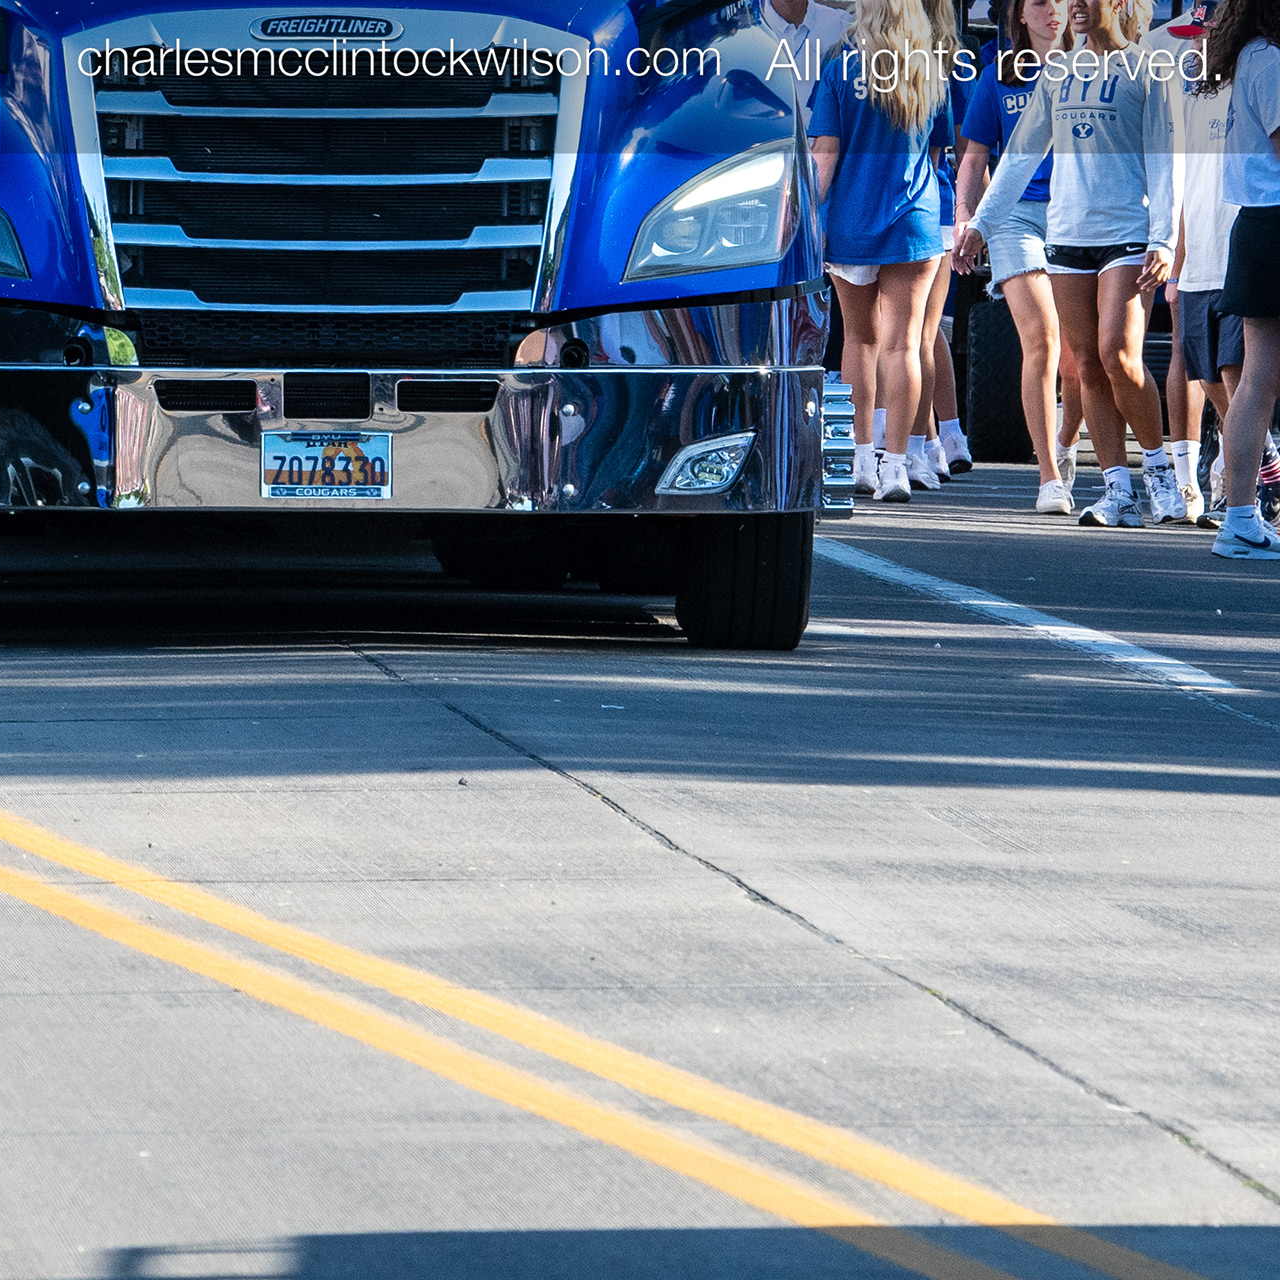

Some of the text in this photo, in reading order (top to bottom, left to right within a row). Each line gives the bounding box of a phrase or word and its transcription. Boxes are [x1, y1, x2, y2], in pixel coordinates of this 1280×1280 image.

[267, 18, 387, 34] FREIGHTLINER
[1055, 112, 1118, 122] COUGARS
[295, 487, 358, 497] COUGARS
